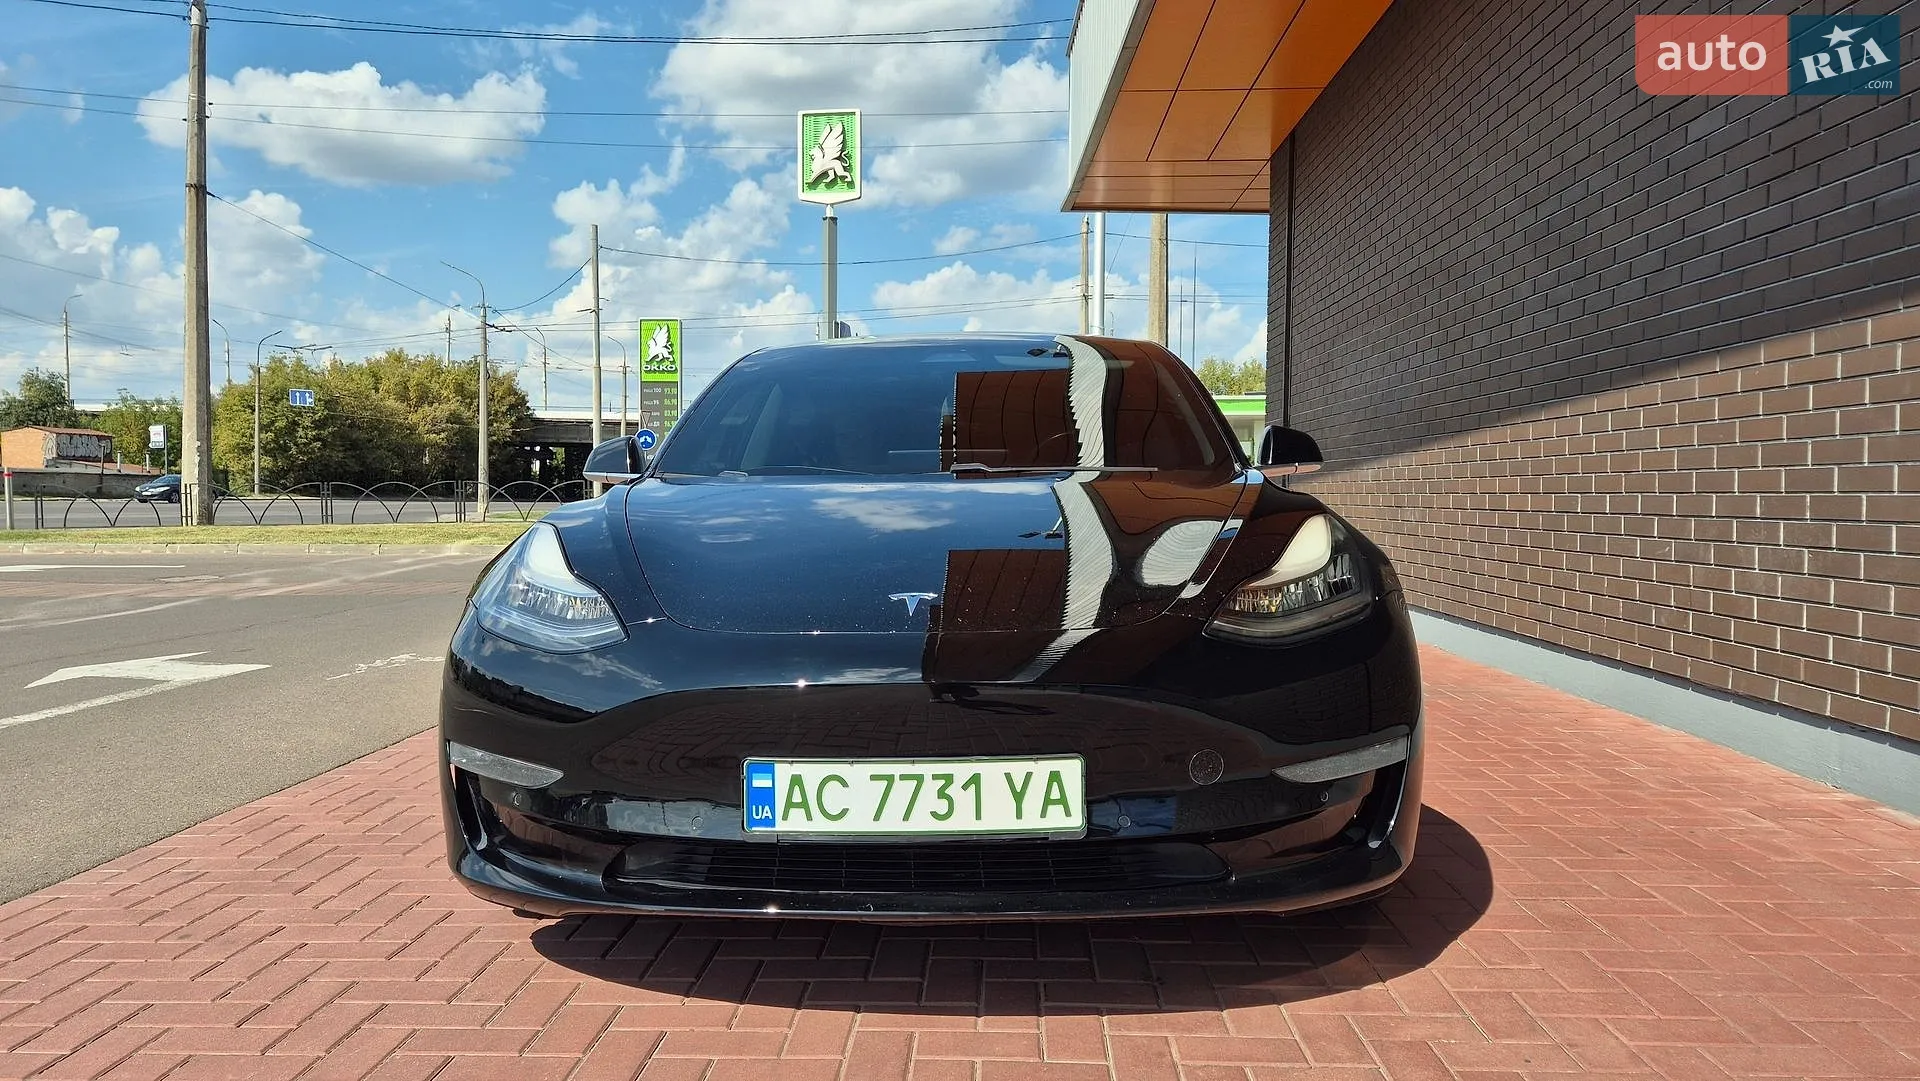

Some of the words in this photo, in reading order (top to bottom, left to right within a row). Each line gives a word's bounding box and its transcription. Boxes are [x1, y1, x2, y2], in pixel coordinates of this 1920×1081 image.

[752, 805, 773, 820] UA
[781, 773, 850, 822] AC
[869, 772, 982, 822] 7731
[1003, 770, 1072, 820] YA
